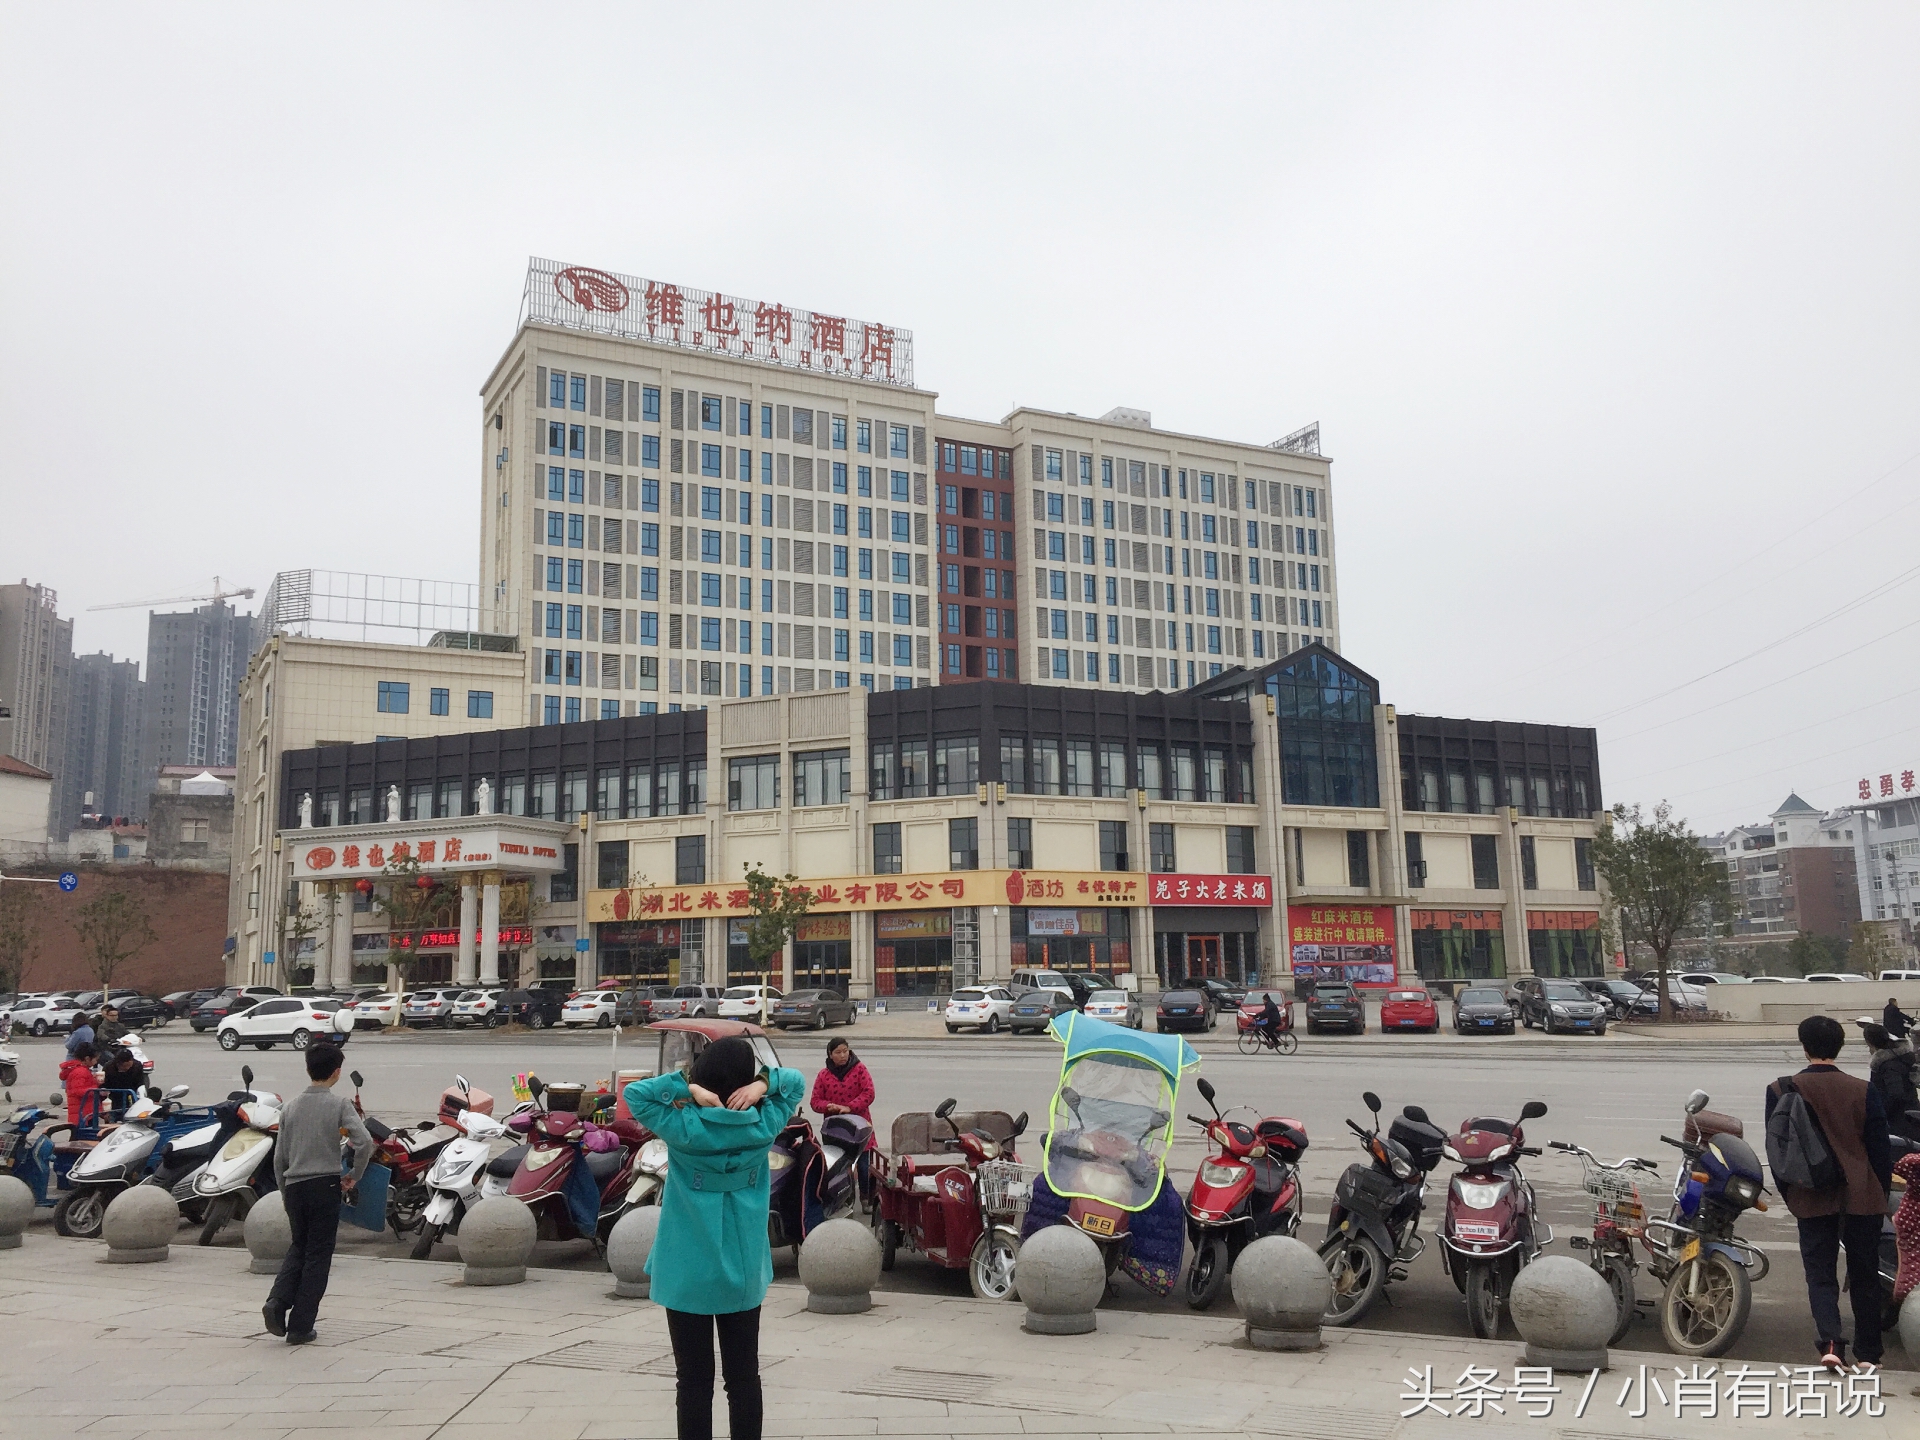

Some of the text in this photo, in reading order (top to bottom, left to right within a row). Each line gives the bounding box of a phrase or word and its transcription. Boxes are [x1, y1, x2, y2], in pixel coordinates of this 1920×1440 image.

[644, 281, 895, 366] 维也纳酒店
[647, 322, 896, 379] VIENNA HOTEL
[1858, 769, 1915, 800] 忠勇孝
[341, 837, 463, 868] 维也纳酒店
[1076, 879, 1138, 894] 名优特产
[1310, 909, 1375, 925] 红麻米酒苑
[1293, 926, 1343, 943] 盛装进行中
